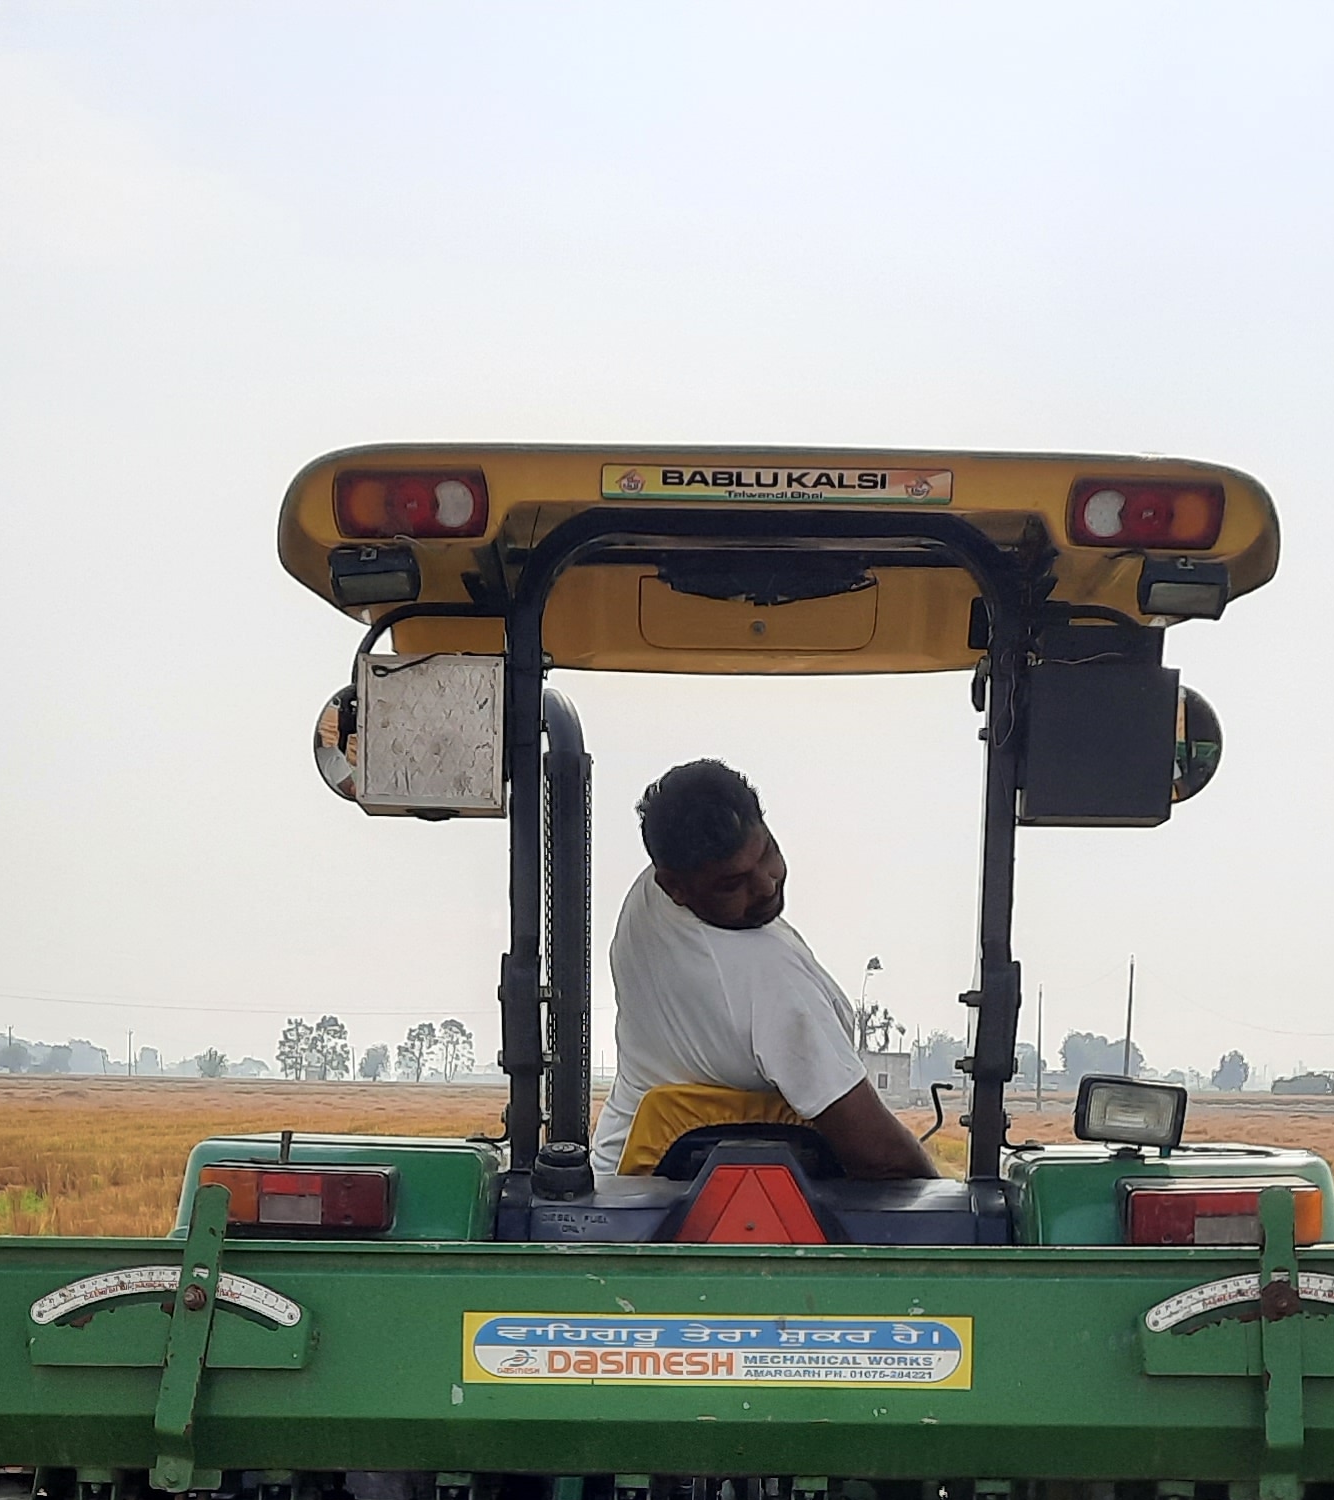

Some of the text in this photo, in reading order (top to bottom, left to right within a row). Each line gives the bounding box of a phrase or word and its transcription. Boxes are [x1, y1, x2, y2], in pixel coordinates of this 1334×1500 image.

[661, 469, 778, 489] BABLU
[785, 470, 887, 490] KALSI
[541, 1212, 609, 1224] DIESEL FUEL
[496, 1323, 665, 1347] ਵਾਹਿਗੁਰੂ
[679, 1323, 762, 1343] ਤੇਰਾ
[743, 1355, 933, 1367] MECHANICAL WORKS
[743, 1369, 820, 1378] AMARGARH
